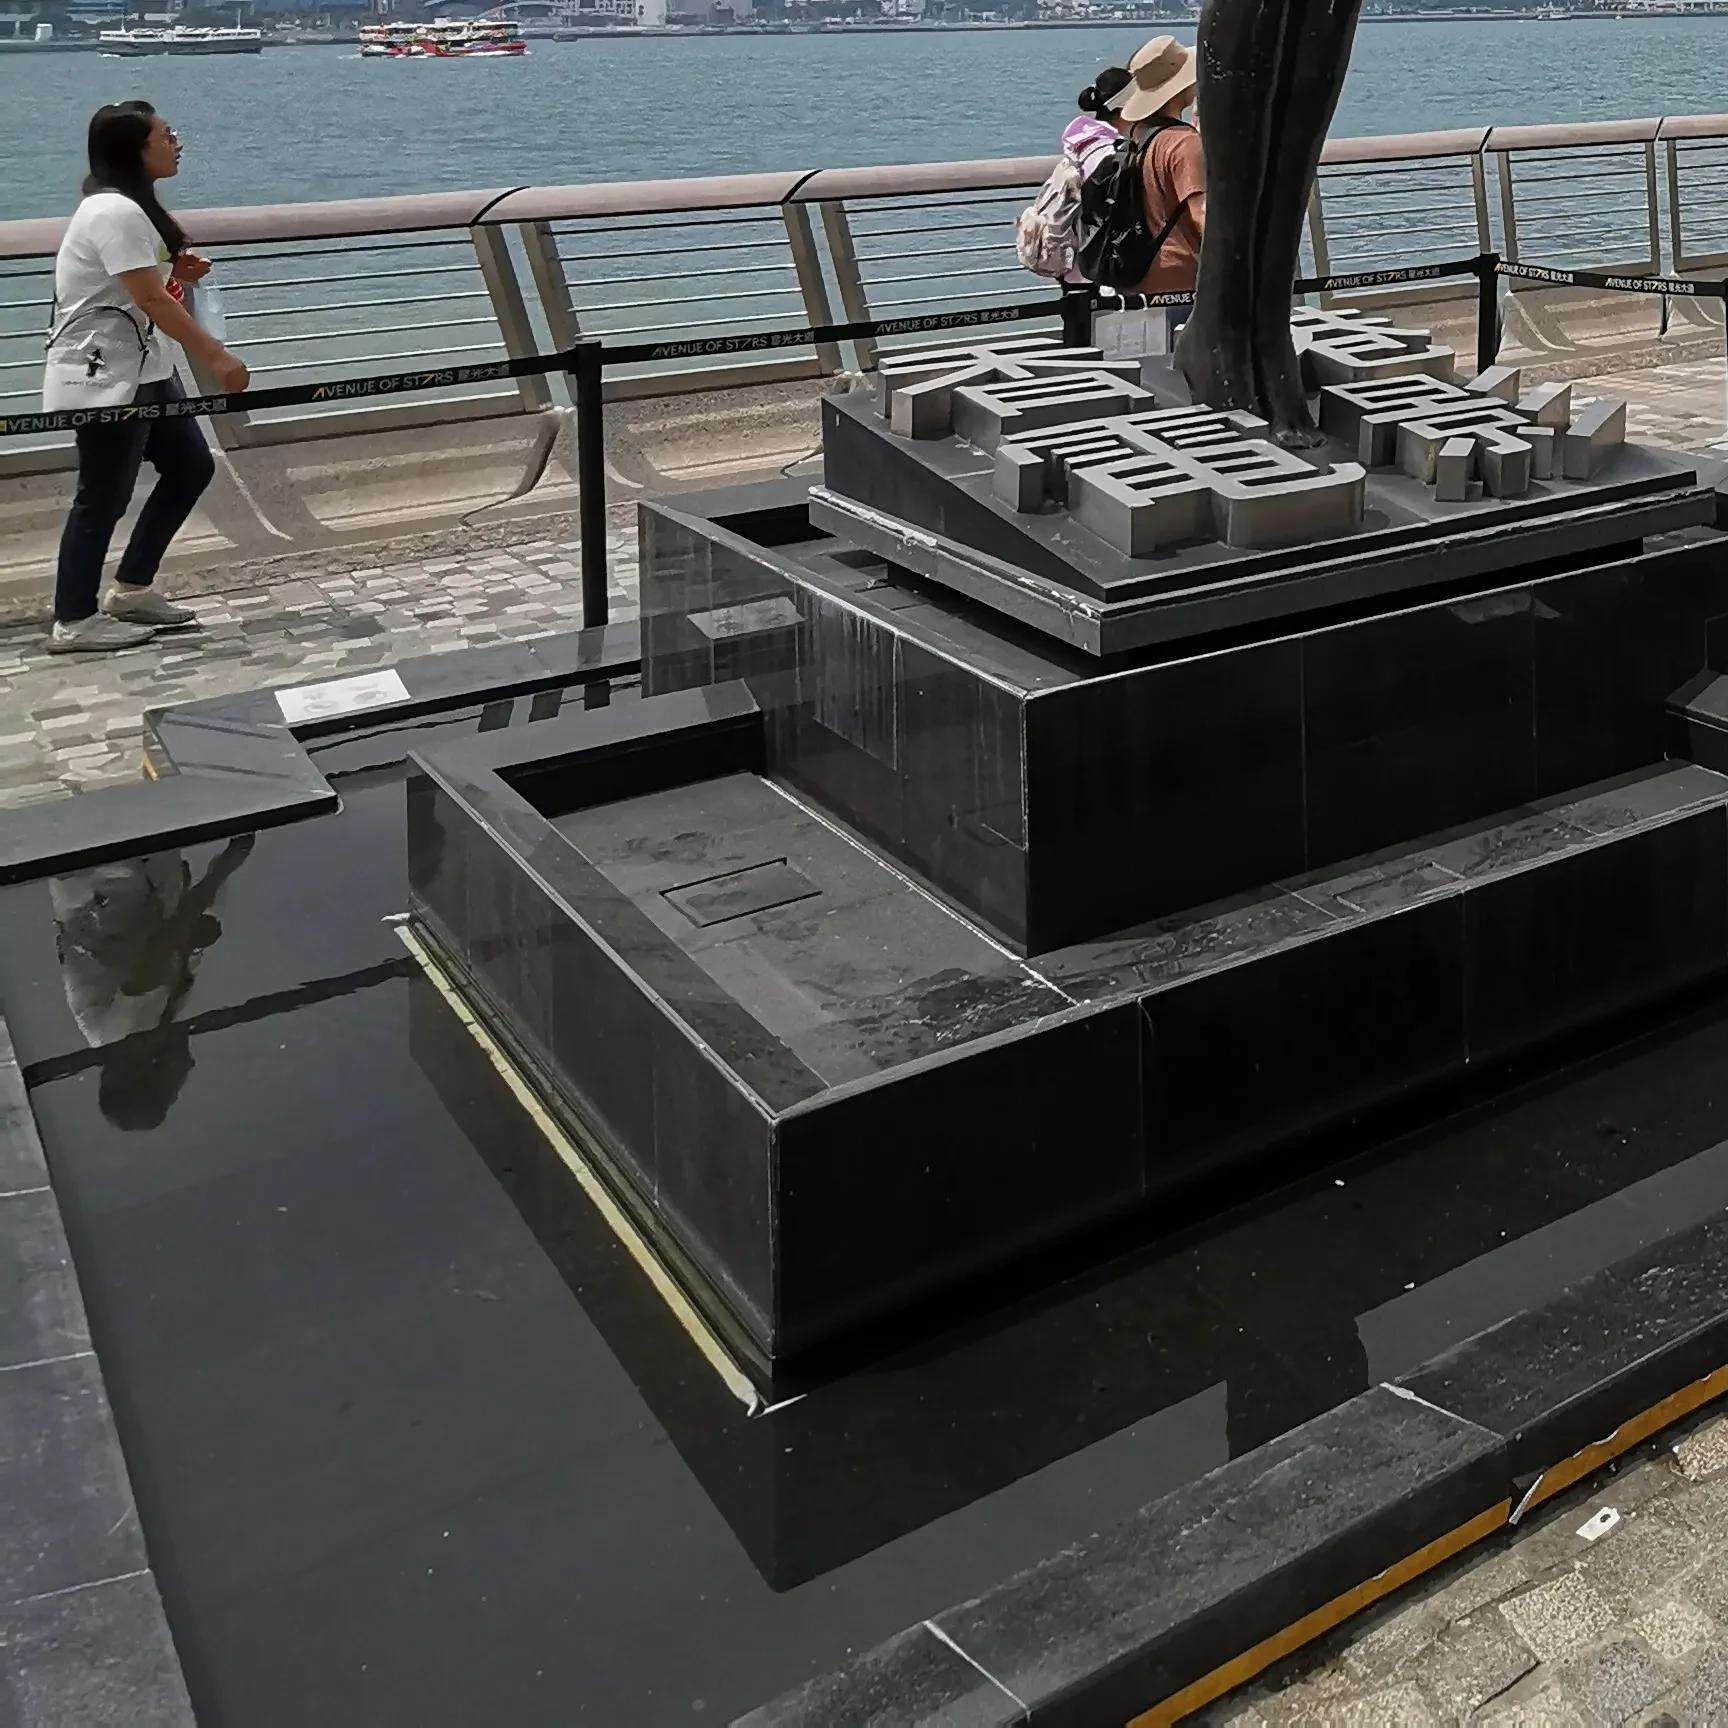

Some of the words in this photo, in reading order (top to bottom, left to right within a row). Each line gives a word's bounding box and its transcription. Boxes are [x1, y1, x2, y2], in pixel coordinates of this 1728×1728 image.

[1325, 276, 1361, 289] AVENUE
[1362, 274, 1375, 284] OF
[1149, 292, 1192, 306] AVENUE
[875, 320, 921, 334] AVENUE
[923, 316, 938, 329] OF
[652, 341, 703, 358] AVENUE
[706, 339, 723, 352] OF
[311, 379, 375, 400] AVENUE
[379, 377, 400, 390] OF
[72, 410, 96, 426] OF
